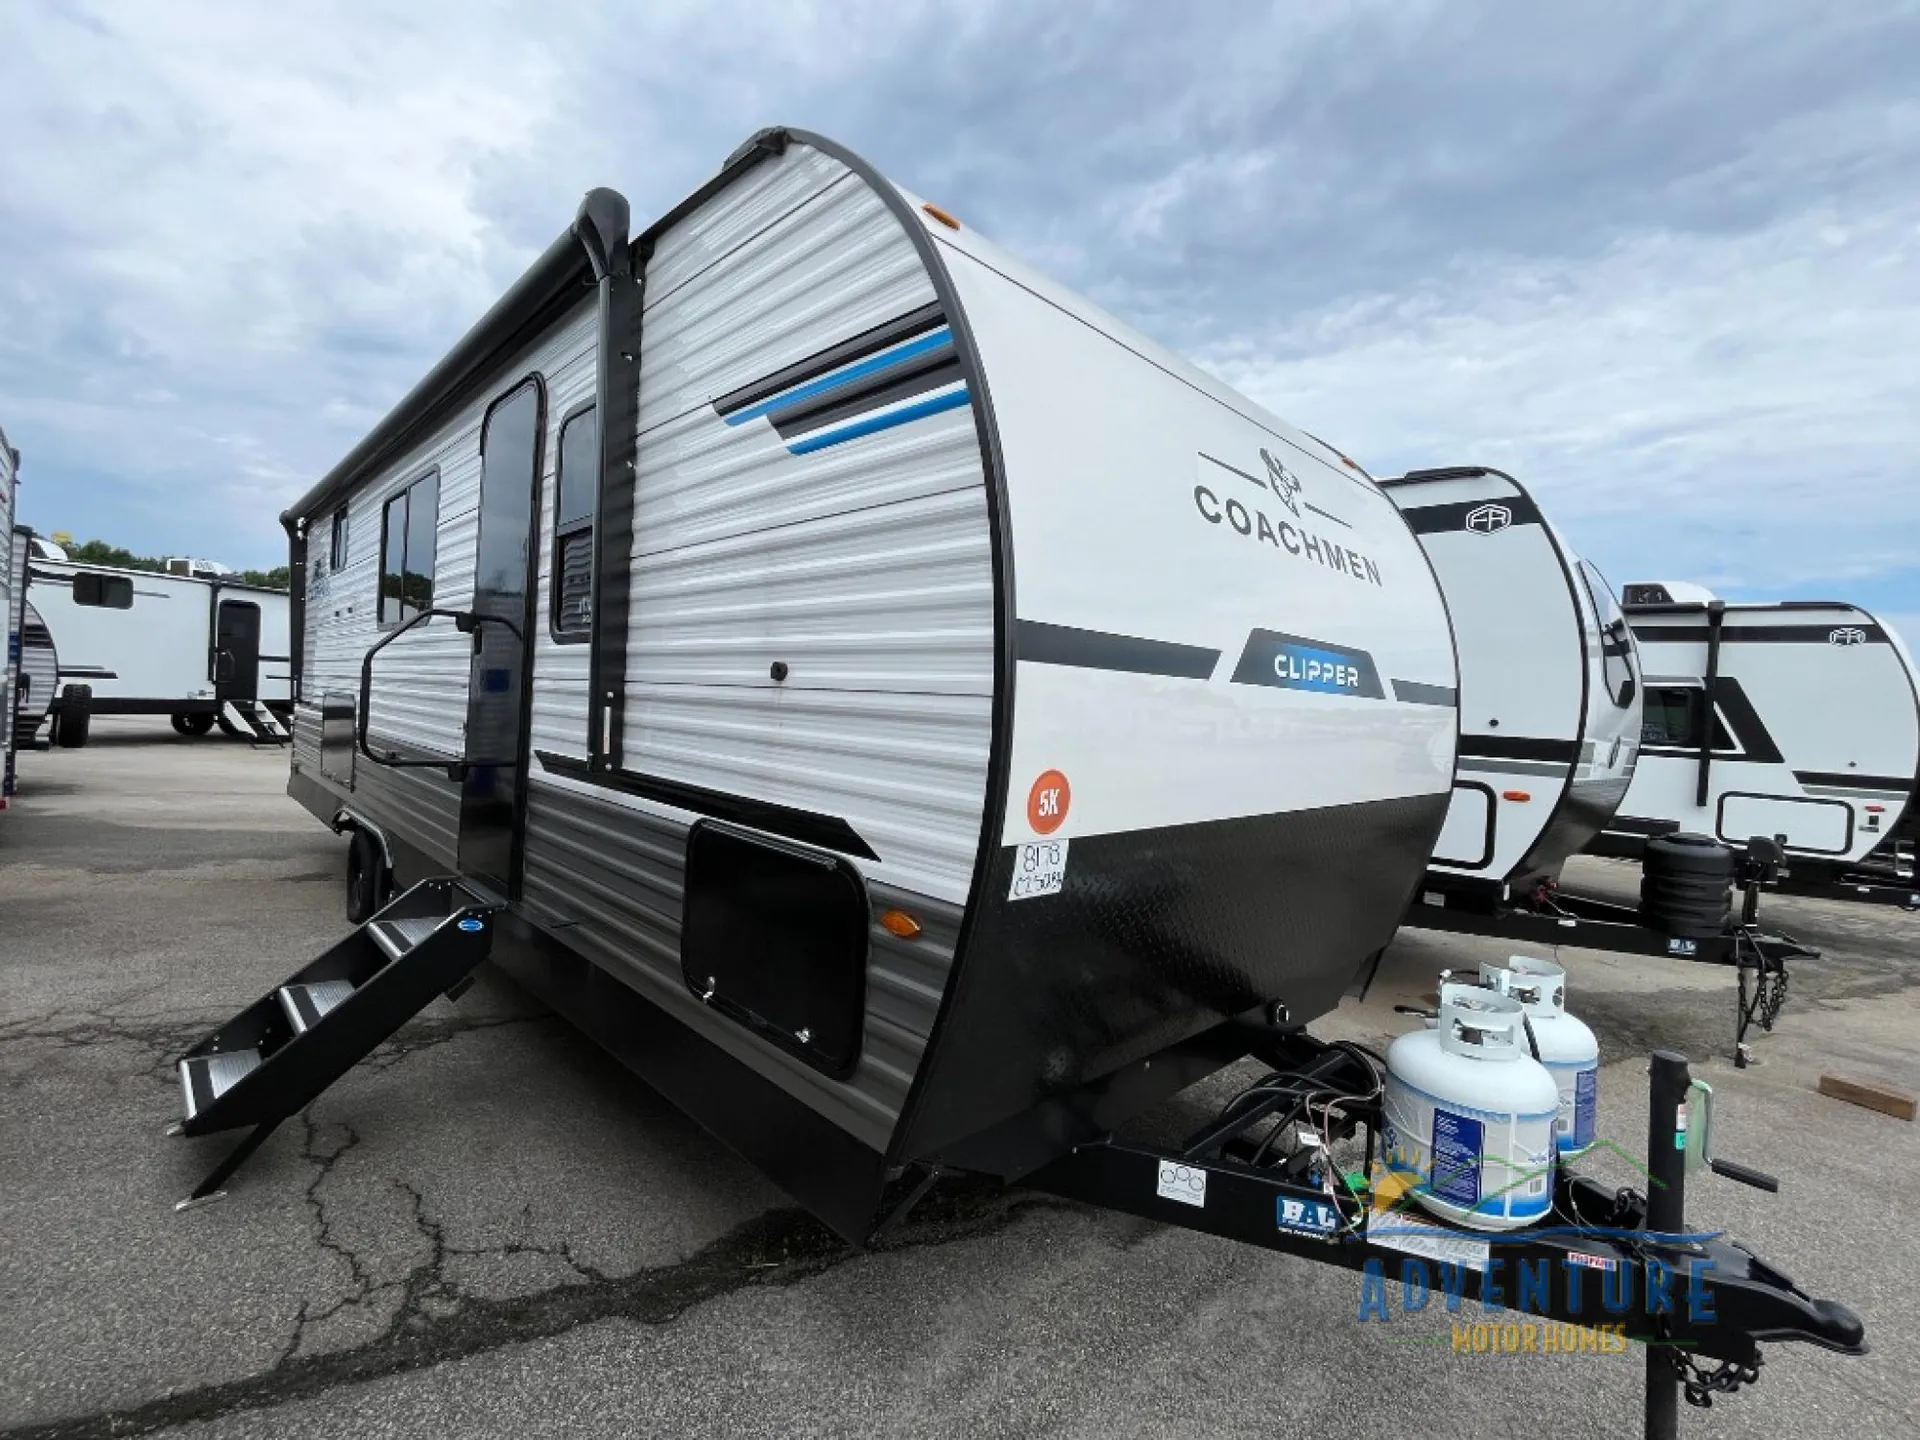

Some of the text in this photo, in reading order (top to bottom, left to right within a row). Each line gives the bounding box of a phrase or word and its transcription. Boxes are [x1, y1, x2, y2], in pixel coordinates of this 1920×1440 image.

[1194, 485, 1382, 586] COACHMEN
[1274, 654, 1359, 687] CLIPPER
[1038, 788, 1060, 817] 5K
